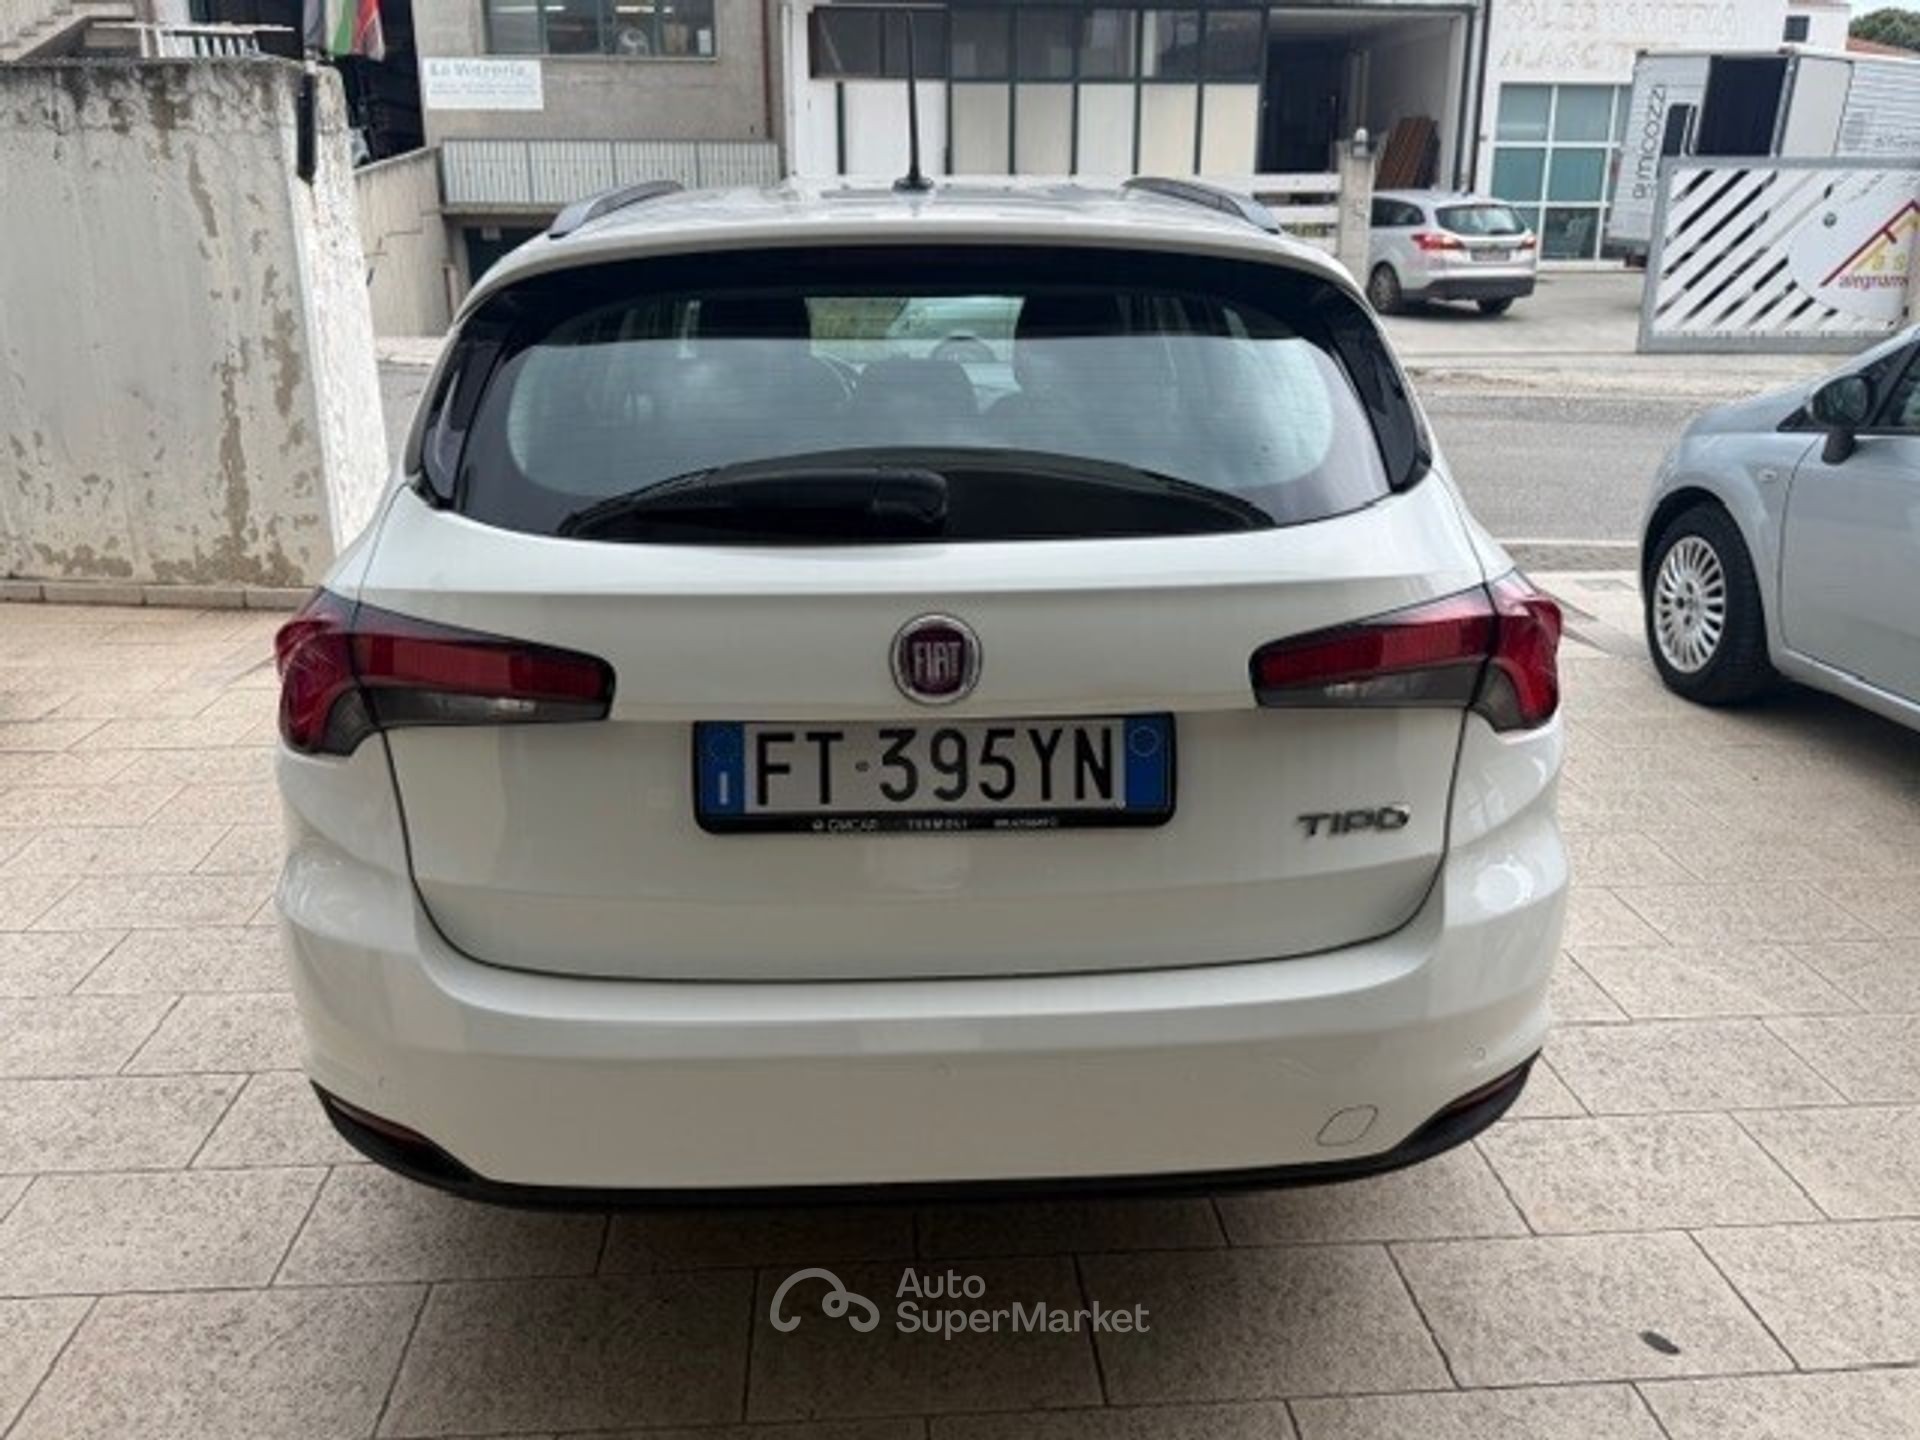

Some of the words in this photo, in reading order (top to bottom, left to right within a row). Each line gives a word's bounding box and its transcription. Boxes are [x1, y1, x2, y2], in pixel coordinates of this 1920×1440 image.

[912, 641, 962, 682] FIAT
[756, 731, 843, 806] FT
[878, 727, 1115, 803] 395YN
[1298, 806, 1409, 837] TIPO
